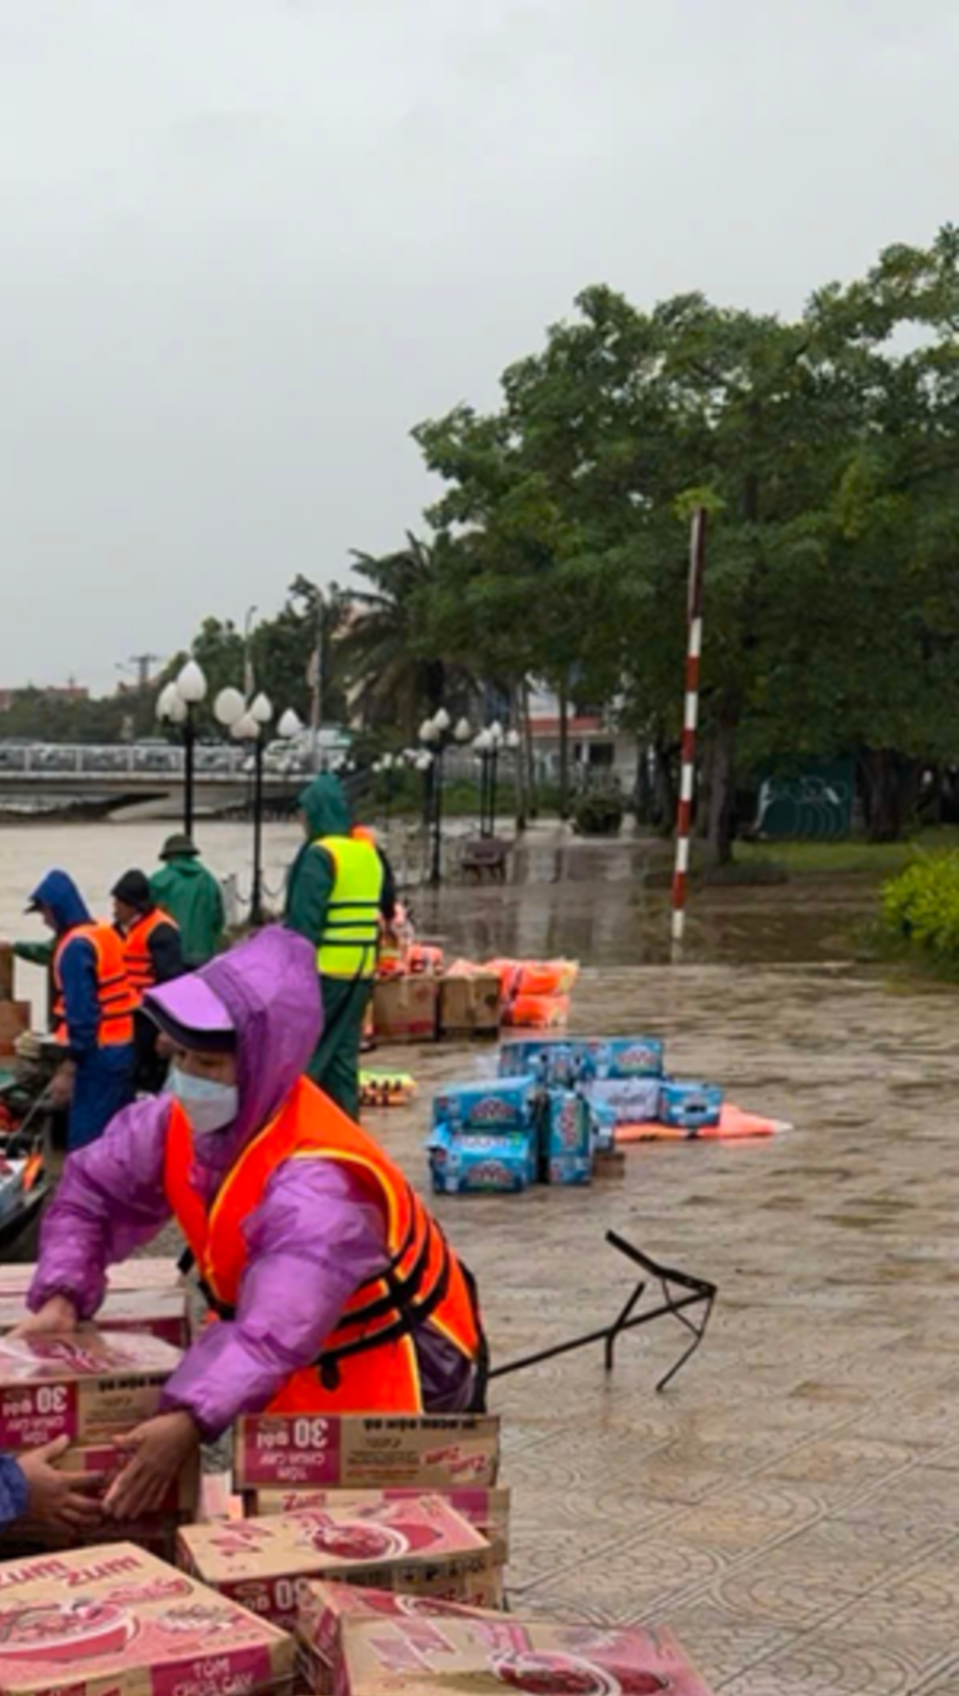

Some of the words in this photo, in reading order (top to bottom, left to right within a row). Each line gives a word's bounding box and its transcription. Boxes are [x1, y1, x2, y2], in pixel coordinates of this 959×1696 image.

[37, 1387, 67, 1413] 30
[295, 1419, 328, 1447] 30
[193, 1658, 230, 1678] TÔM
